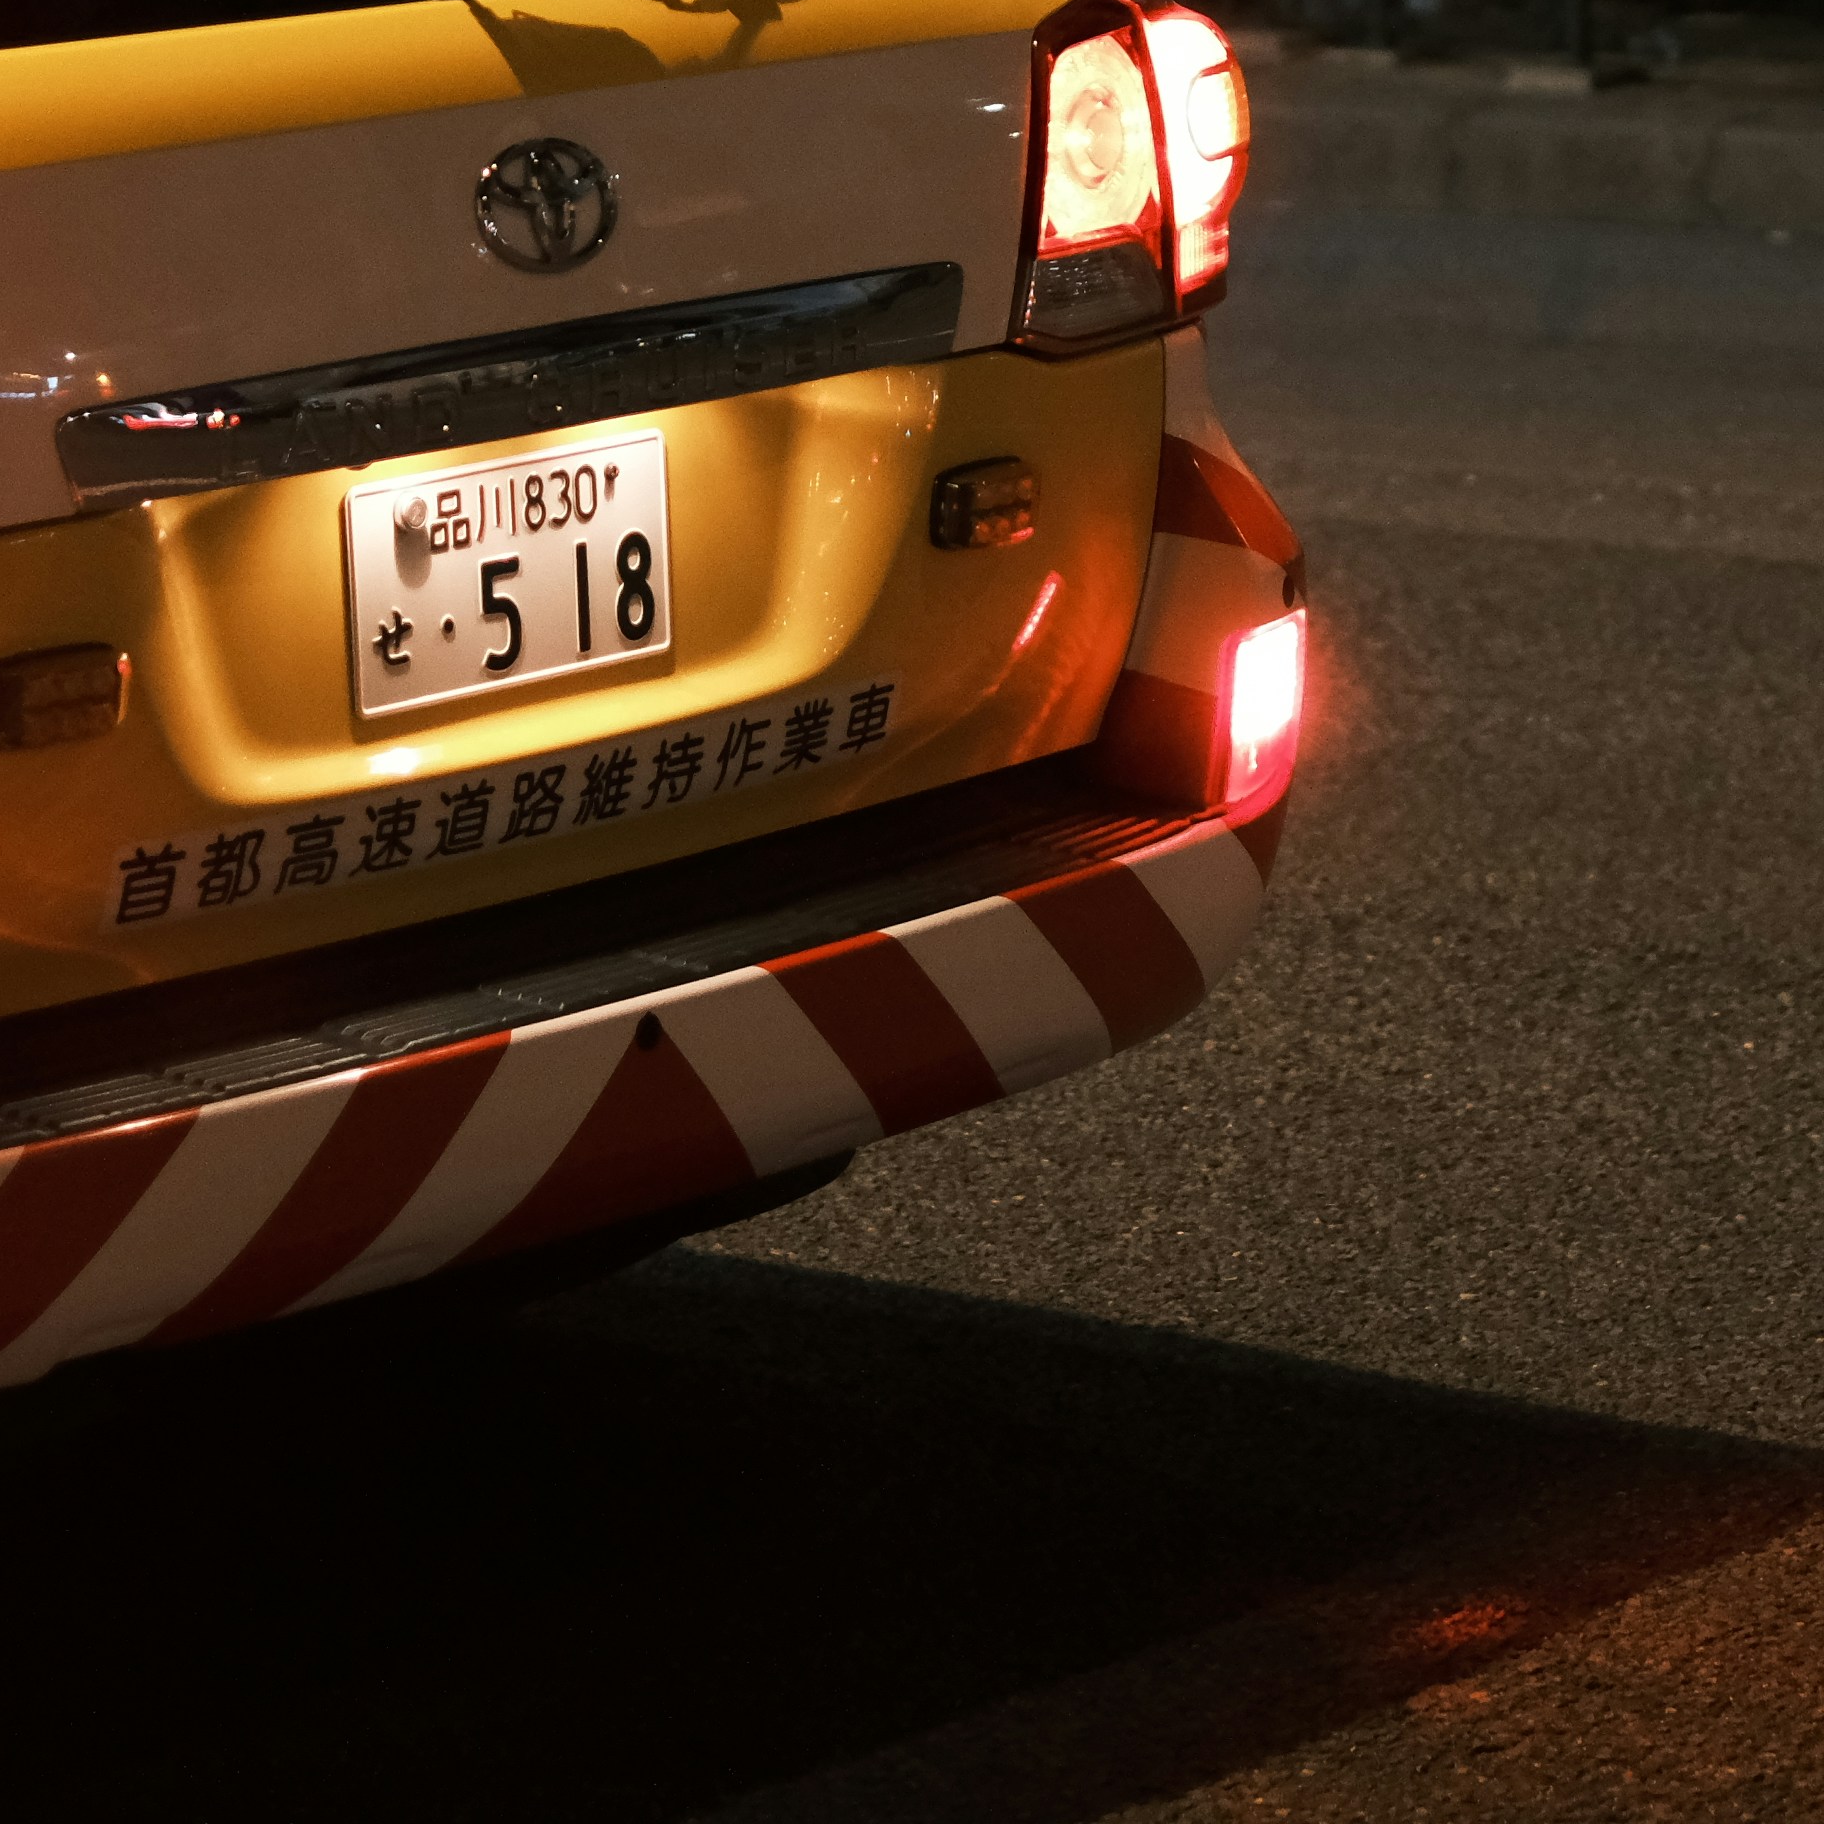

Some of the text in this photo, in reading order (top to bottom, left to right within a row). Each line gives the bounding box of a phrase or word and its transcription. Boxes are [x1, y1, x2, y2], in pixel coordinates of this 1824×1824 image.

[116, 682, 895, 924] 首都高速道路維持作業車
